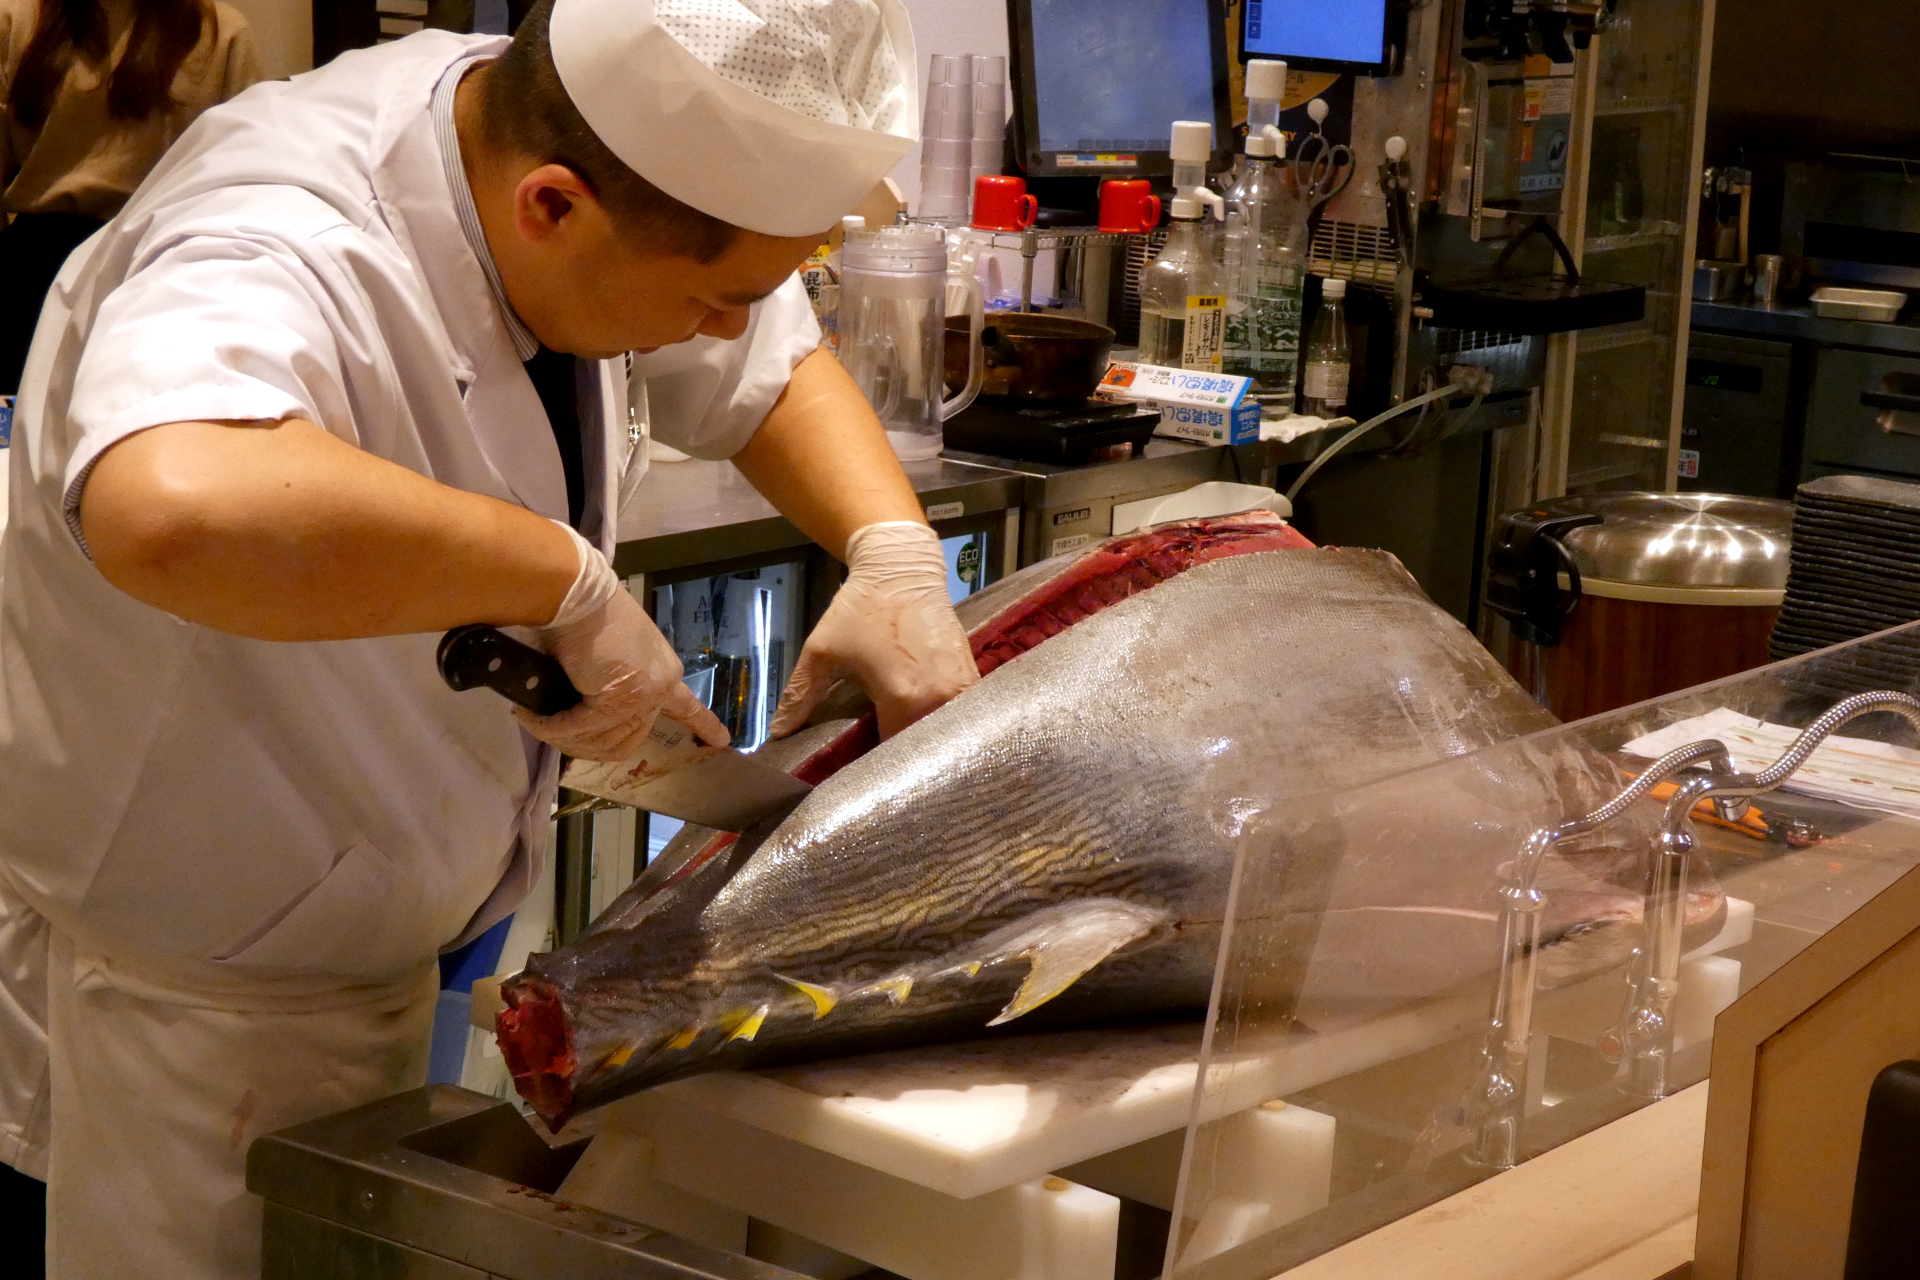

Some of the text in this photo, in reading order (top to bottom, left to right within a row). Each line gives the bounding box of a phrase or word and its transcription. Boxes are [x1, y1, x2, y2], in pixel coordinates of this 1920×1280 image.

[1172, 374, 1235, 393] 環境思い
[1161, 405, 1223, 425] 環境思い
[959, 548, 979, 563] ECO
[693, 611, 729, 629] FRE
